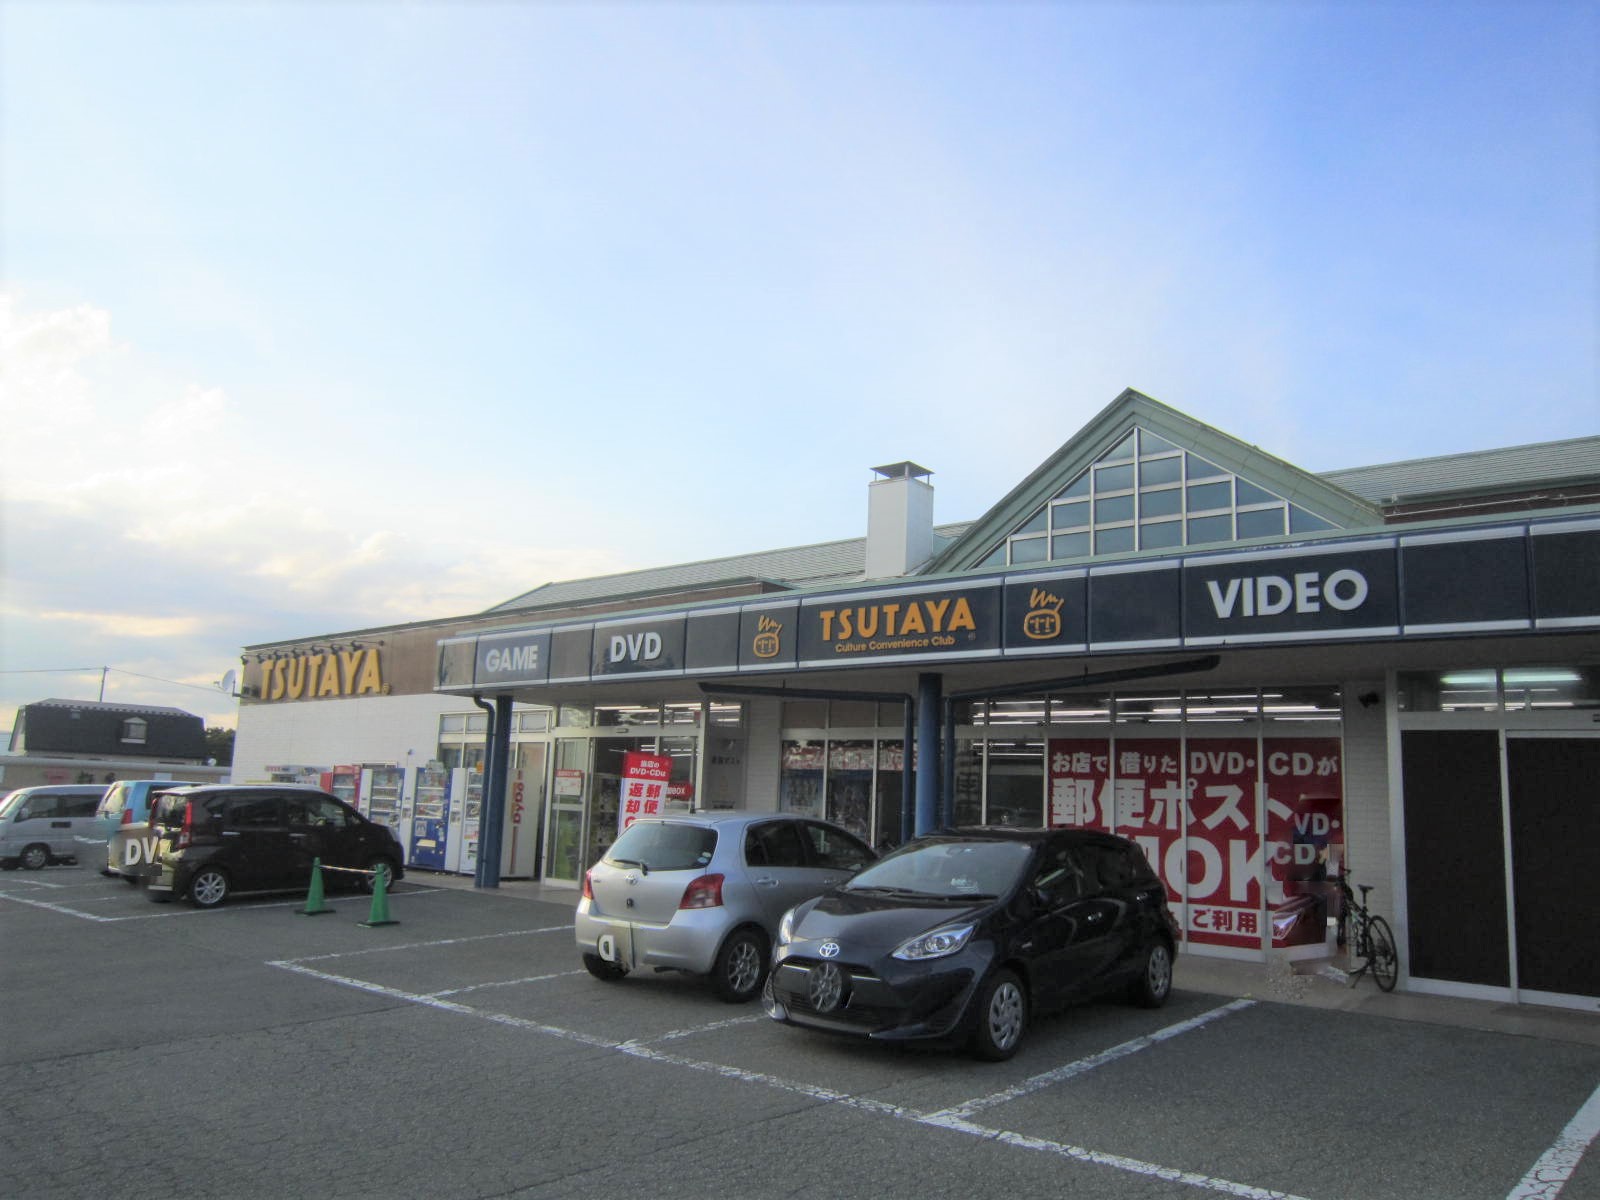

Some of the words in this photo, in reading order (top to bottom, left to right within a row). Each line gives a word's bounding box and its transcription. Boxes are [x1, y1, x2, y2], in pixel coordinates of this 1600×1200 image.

[1207, 569, 1368, 619] VIDEO
[820, 597, 977, 641] TSUTAYA
[485, 645, 539, 673] GAME
[610, 632, 662, 663] DVD
[835, 642, 867, 653] Culture
[869, 637, 929, 650] Convenience
[931, 634, 956, 646] Club
[260, 647, 381, 700] TSUTAYA
[1052, 777, 1293, 834] 郵便ポスト
